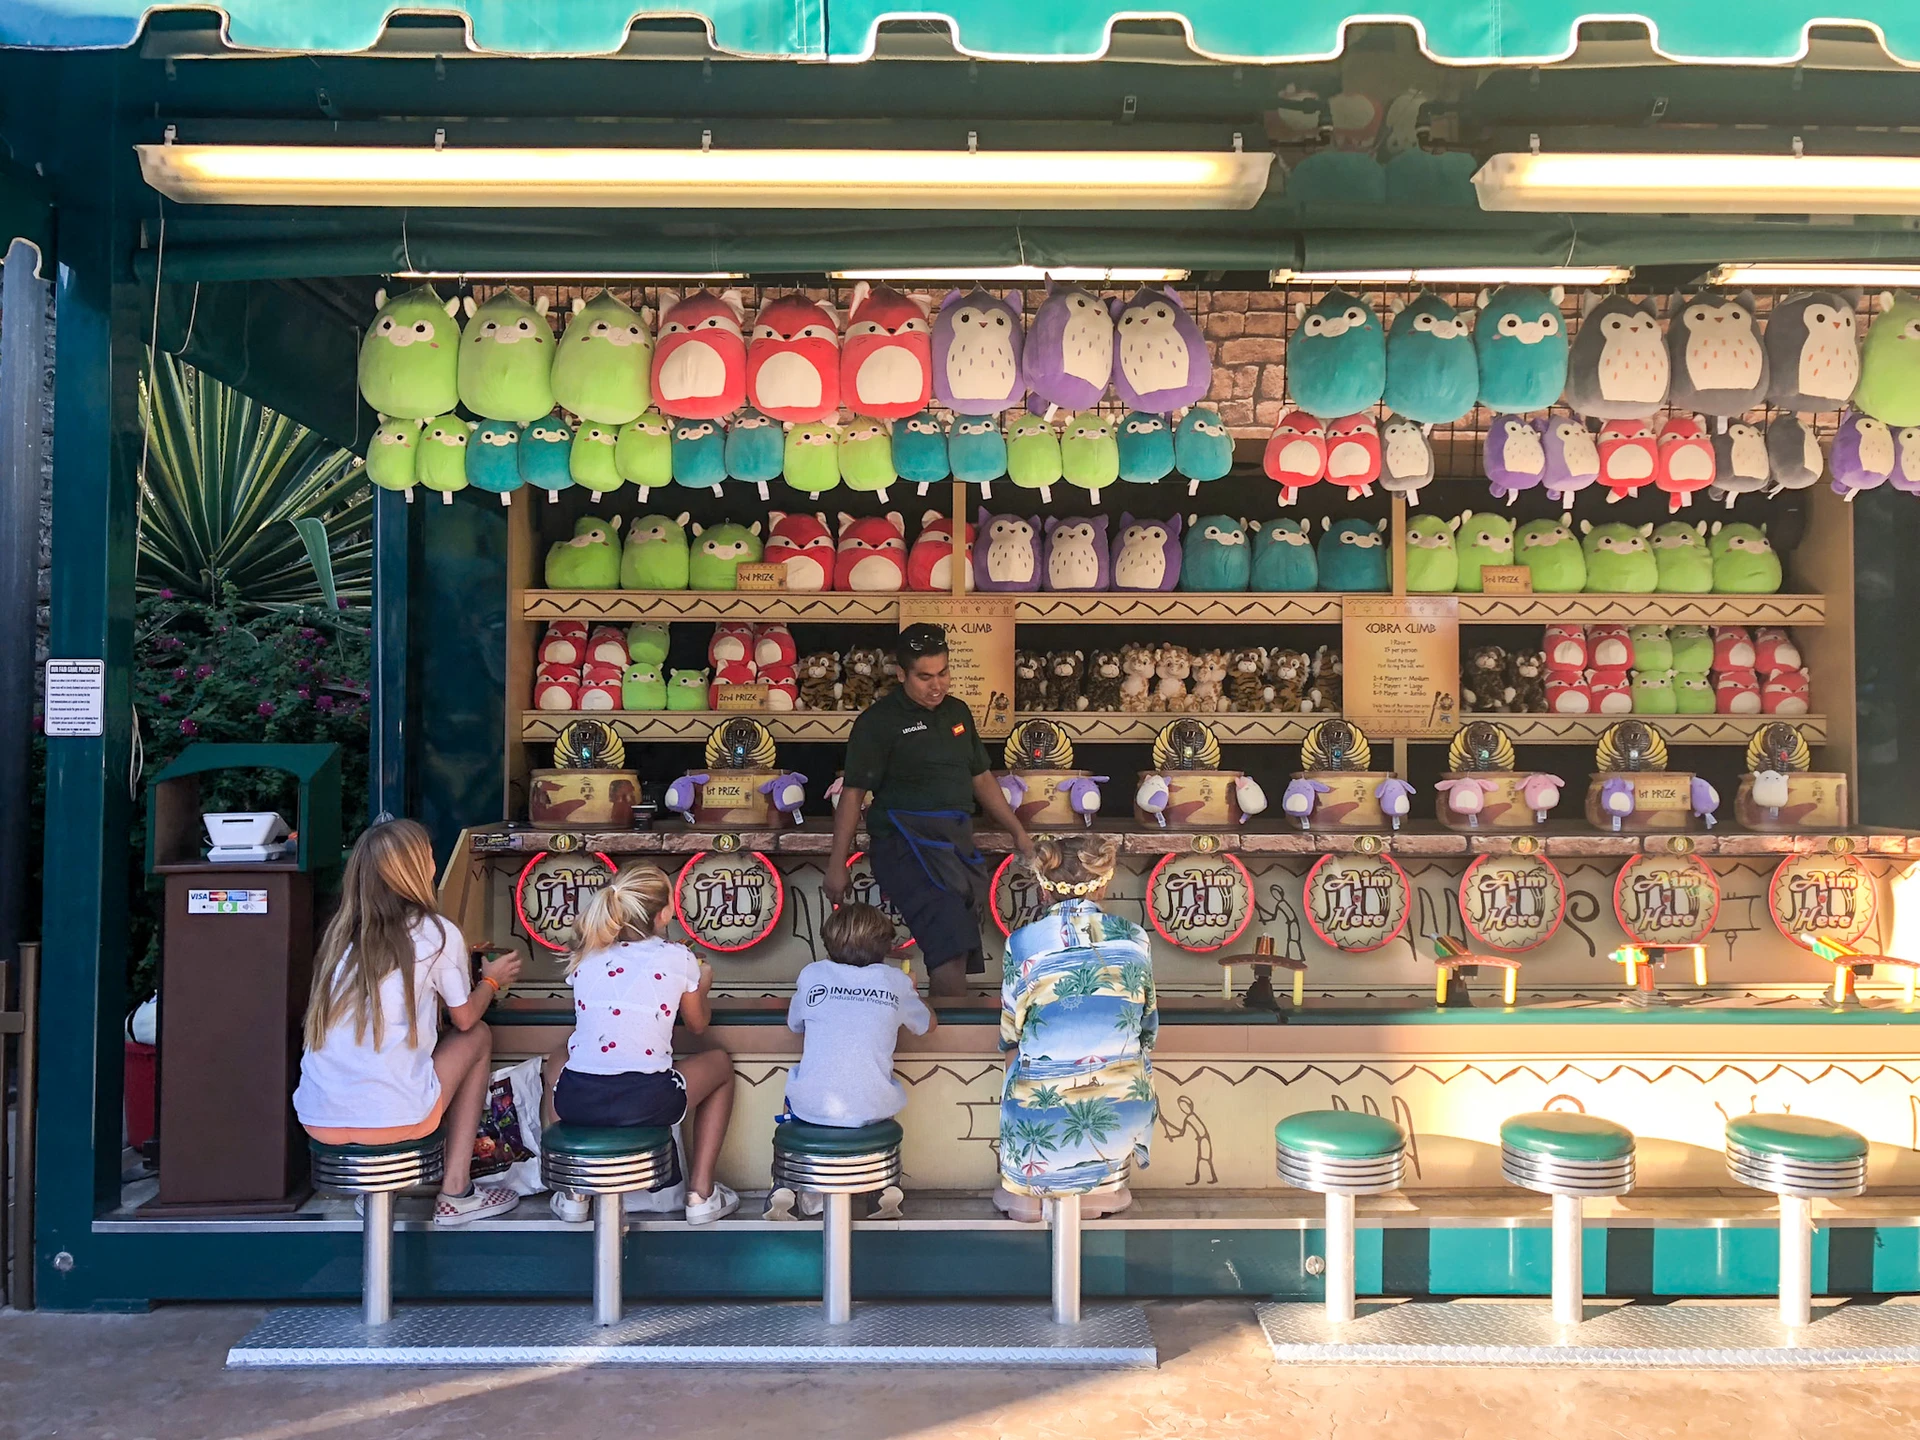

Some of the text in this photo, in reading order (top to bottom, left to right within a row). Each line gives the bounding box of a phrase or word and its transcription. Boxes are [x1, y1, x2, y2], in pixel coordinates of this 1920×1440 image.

[739, 573, 774, 581] 3rd PRIZE
[1498, 576, 1520, 584] PRIZE
[961, 623, 992, 634] CLIMB
[1365, 623, 1437, 634] COBRA CLIMB
[1409, 683, 1423, 691] Large
[718, 786, 740, 795] PRIZE
[1652, 790, 1676, 798] PRIZE
[560, 836, 566, 848] 1
[723, 836, 730, 849] 2
[1202, 838, 1208, 850] 5
[1364, 838, 1372, 850] 6
[1677, 838, 1684, 850] 8
[1838, 840, 1845, 851] 9
[535, 868, 606, 890] Aim
[694, 868, 764, 890] Aim
[1166, 869, 1234, 890] Aim
[1322, 870, 1392, 890] Aim
[1478, 870, 1547, 891] Aim
[1634, 870, 1700, 891] Aim
[1789, 870, 1858, 892] Aim
[539, 904, 577, 930] He
[698, 904, 758, 930] Here
[1171, 905, 1230, 930] Here
[1328, 906, 1386, 930] Here
[1484, 906, 1542, 930] Here
[1639, 906, 1696, 930] Here
[1793, 906, 1852, 931] Here
[830, 986, 900, 1005] INNOVATIVE
